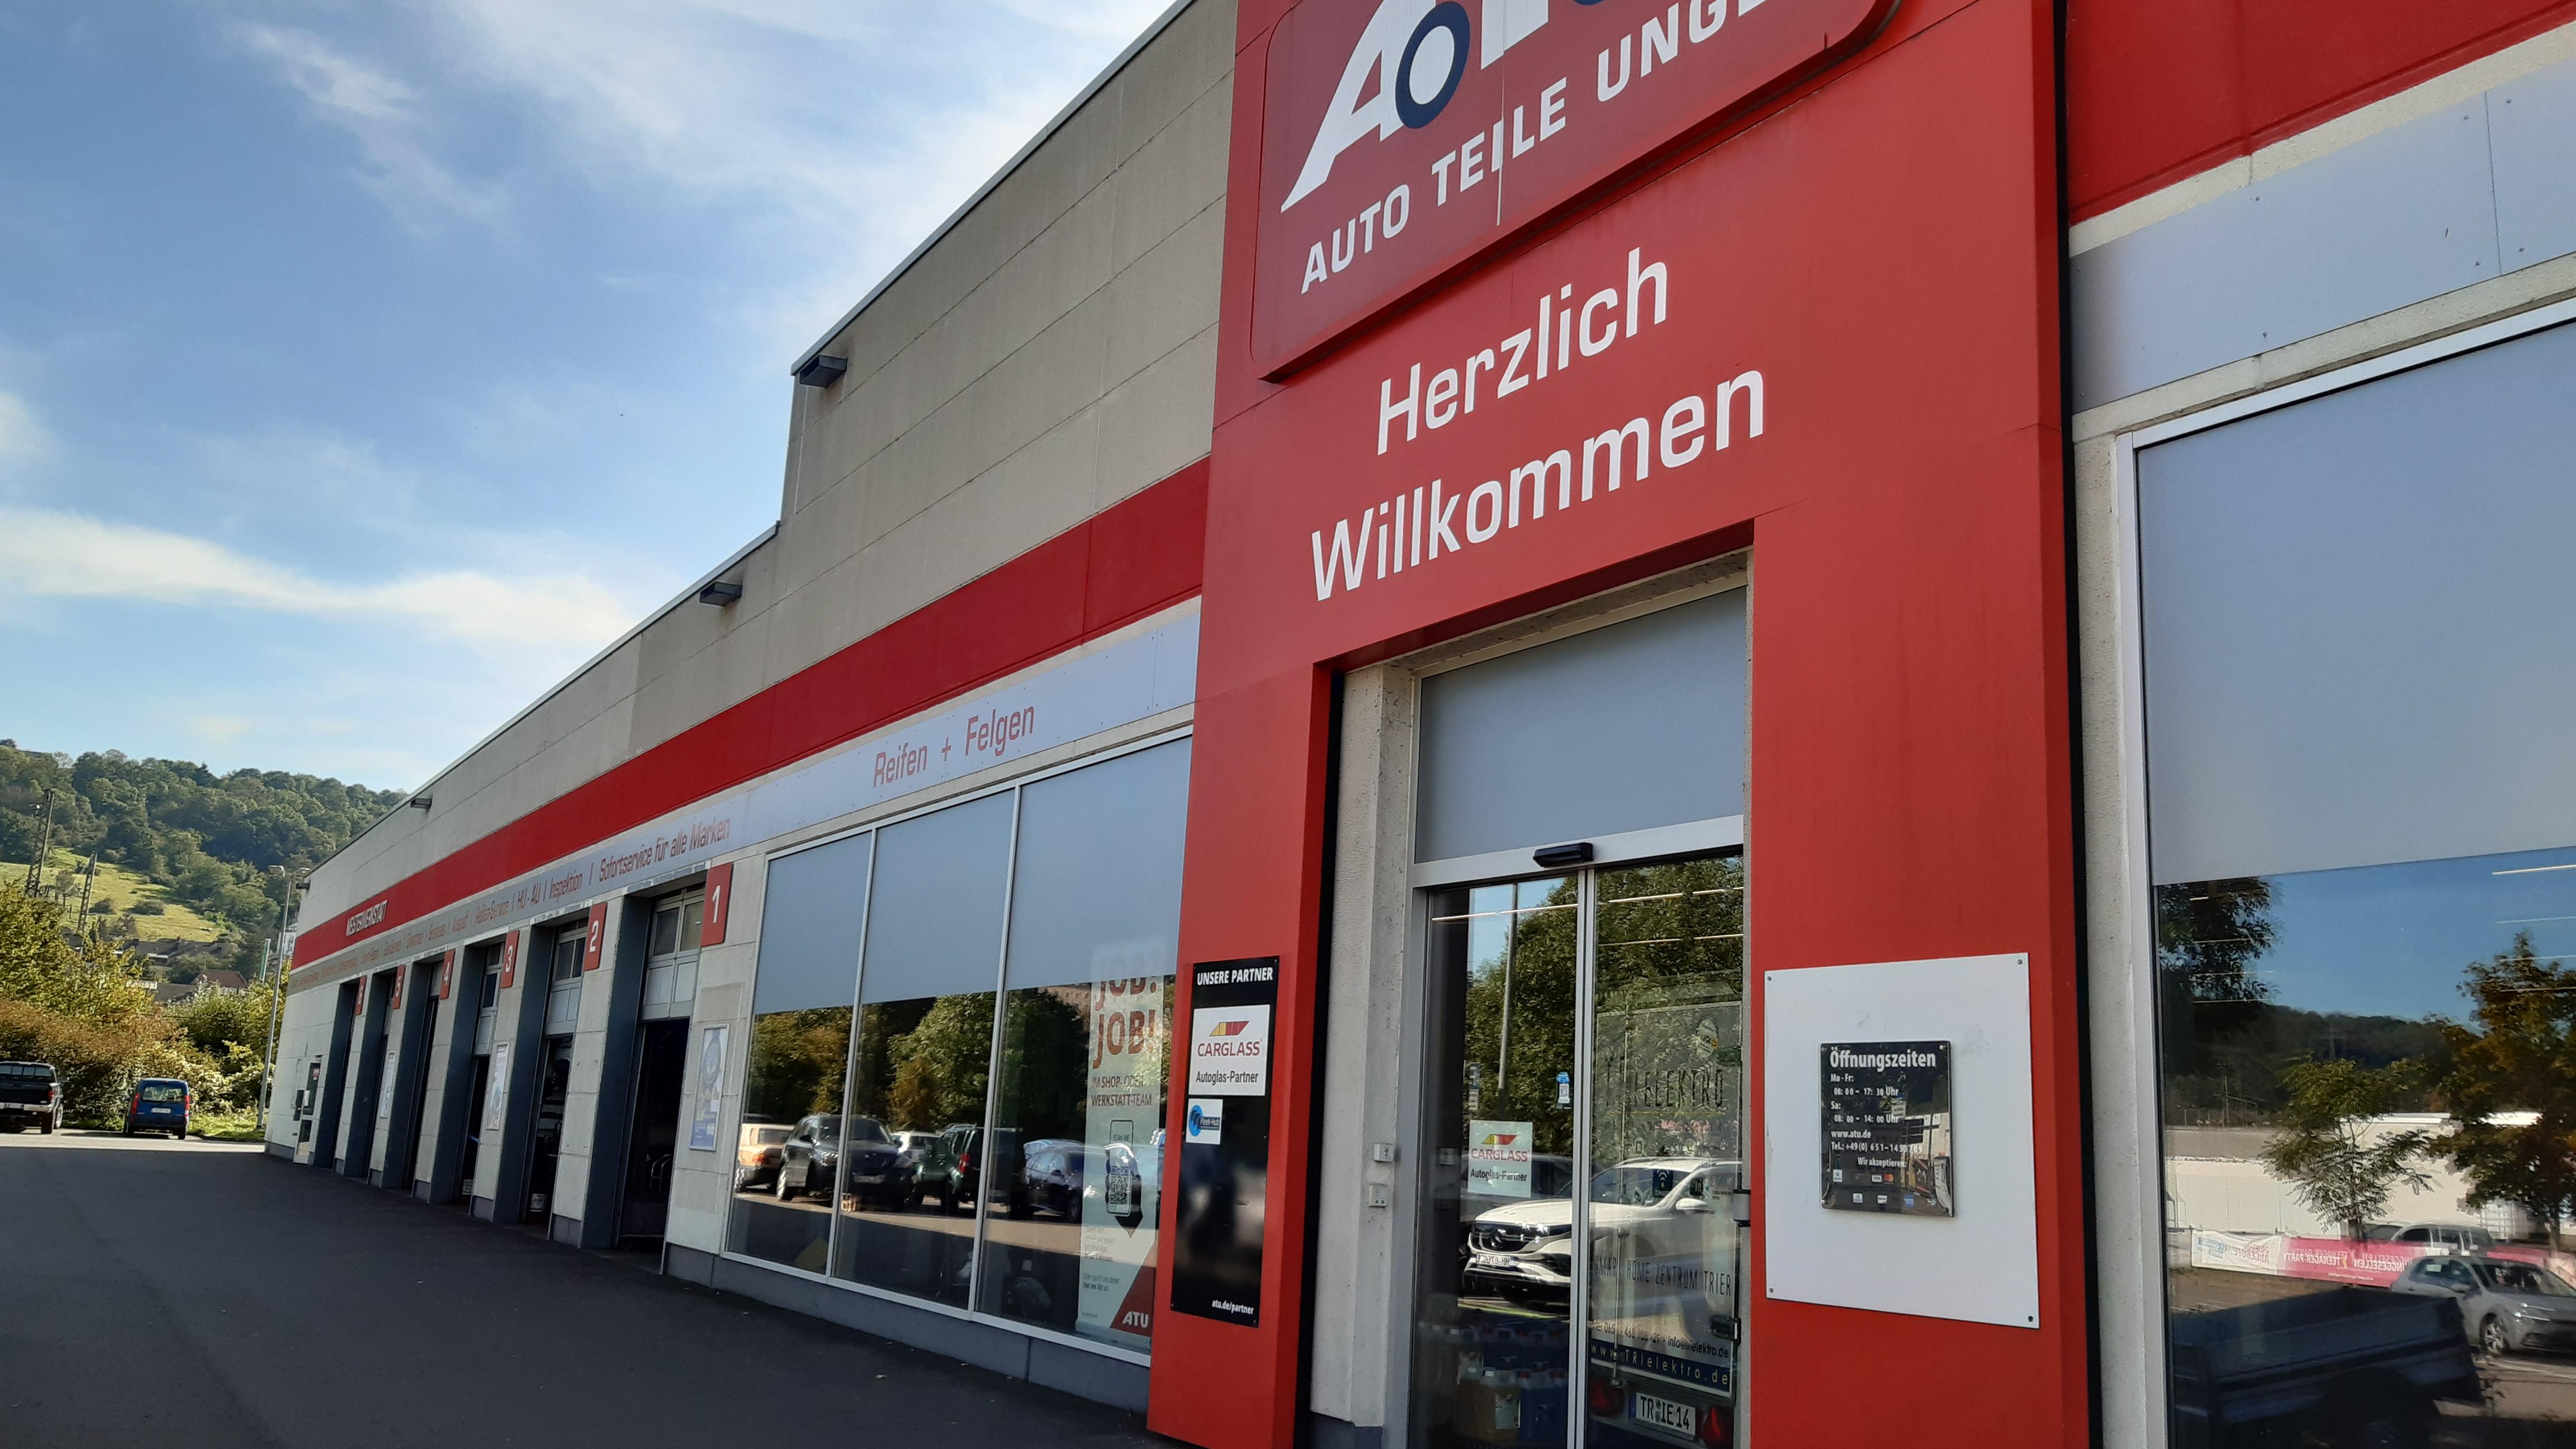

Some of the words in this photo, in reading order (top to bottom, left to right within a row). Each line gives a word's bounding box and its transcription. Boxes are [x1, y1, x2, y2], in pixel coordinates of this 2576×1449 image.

[1301, 183, 1410, 294] AUTO
[1432, 77, 1566, 206] TEILE
[1597, 0, 1768, 102] UNG
[1376, 246, 1668, 455] Herzlich
[1311, 370, 1764, 602] Willkommen
[873, 741, 928, 788] Reifen
[941, 737, 951, 762] +
[965, 705, 1034, 756] Felgen
[599, 846, 652, 882] Sofortservice
[655, 836, 669, 863] für
[671, 830, 688, 857] alle
[689, 816, 731, 851] Marken
[712, 885, 721, 923] 1
[589, 921, 599, 953] 2
[505, 945, 513, 973] 3
[444, 962, 451, 986] 4
[1197, 970, 1229, 986] UNSERE
[1231, 967, 1273, 983] PARTNER
[1092, 1010, 1156, 1068] JOB!
[1197, 1041, 1260, 1057] CARGLASS
[1830, 1046, 1936, 1072] Öffnungszeiten
[1092, 1077, 1100, 1088] IM
[1102, 1076, 1122, 1088] SHOP-
[1124, 1075, 1143, 1087] ODER
[1196, 1070, 1258, 1086] Autoglas-Partner
[1886, 1086, 1899, 1096] Uhr
[1091, 1094, 1152, 1106] WERKSTATT-TEAM
[1831, 1101, 1841, 1110] Sa:
[1886, 1114, 1899, 1123] Uhr
[1831, 1129, 1871, 1138] www.atu.de
[1831, 1142, 1844, 1150] Tel.:
[1471, 1148, 1528, 1162] CARGLASS
[1857, 1157, 1868, 1166] Wir
[1869, 1158, 1907, 1168] akzeptieren:
[1470, 1169, 1527, 1181] Autoglas-Partner
[1594, 1255, 1617, 1277] SMAR
[1627, 1260, 1650, 1282] HOME
[1655, 1263, 1697, 1290] ZENTRUM
[1704, 1270, 1731, 1296] TRIER
[1212, 1300, 1254, 1315] atu.de/partner
[1122, 1311, 1149, 1328] ATU
